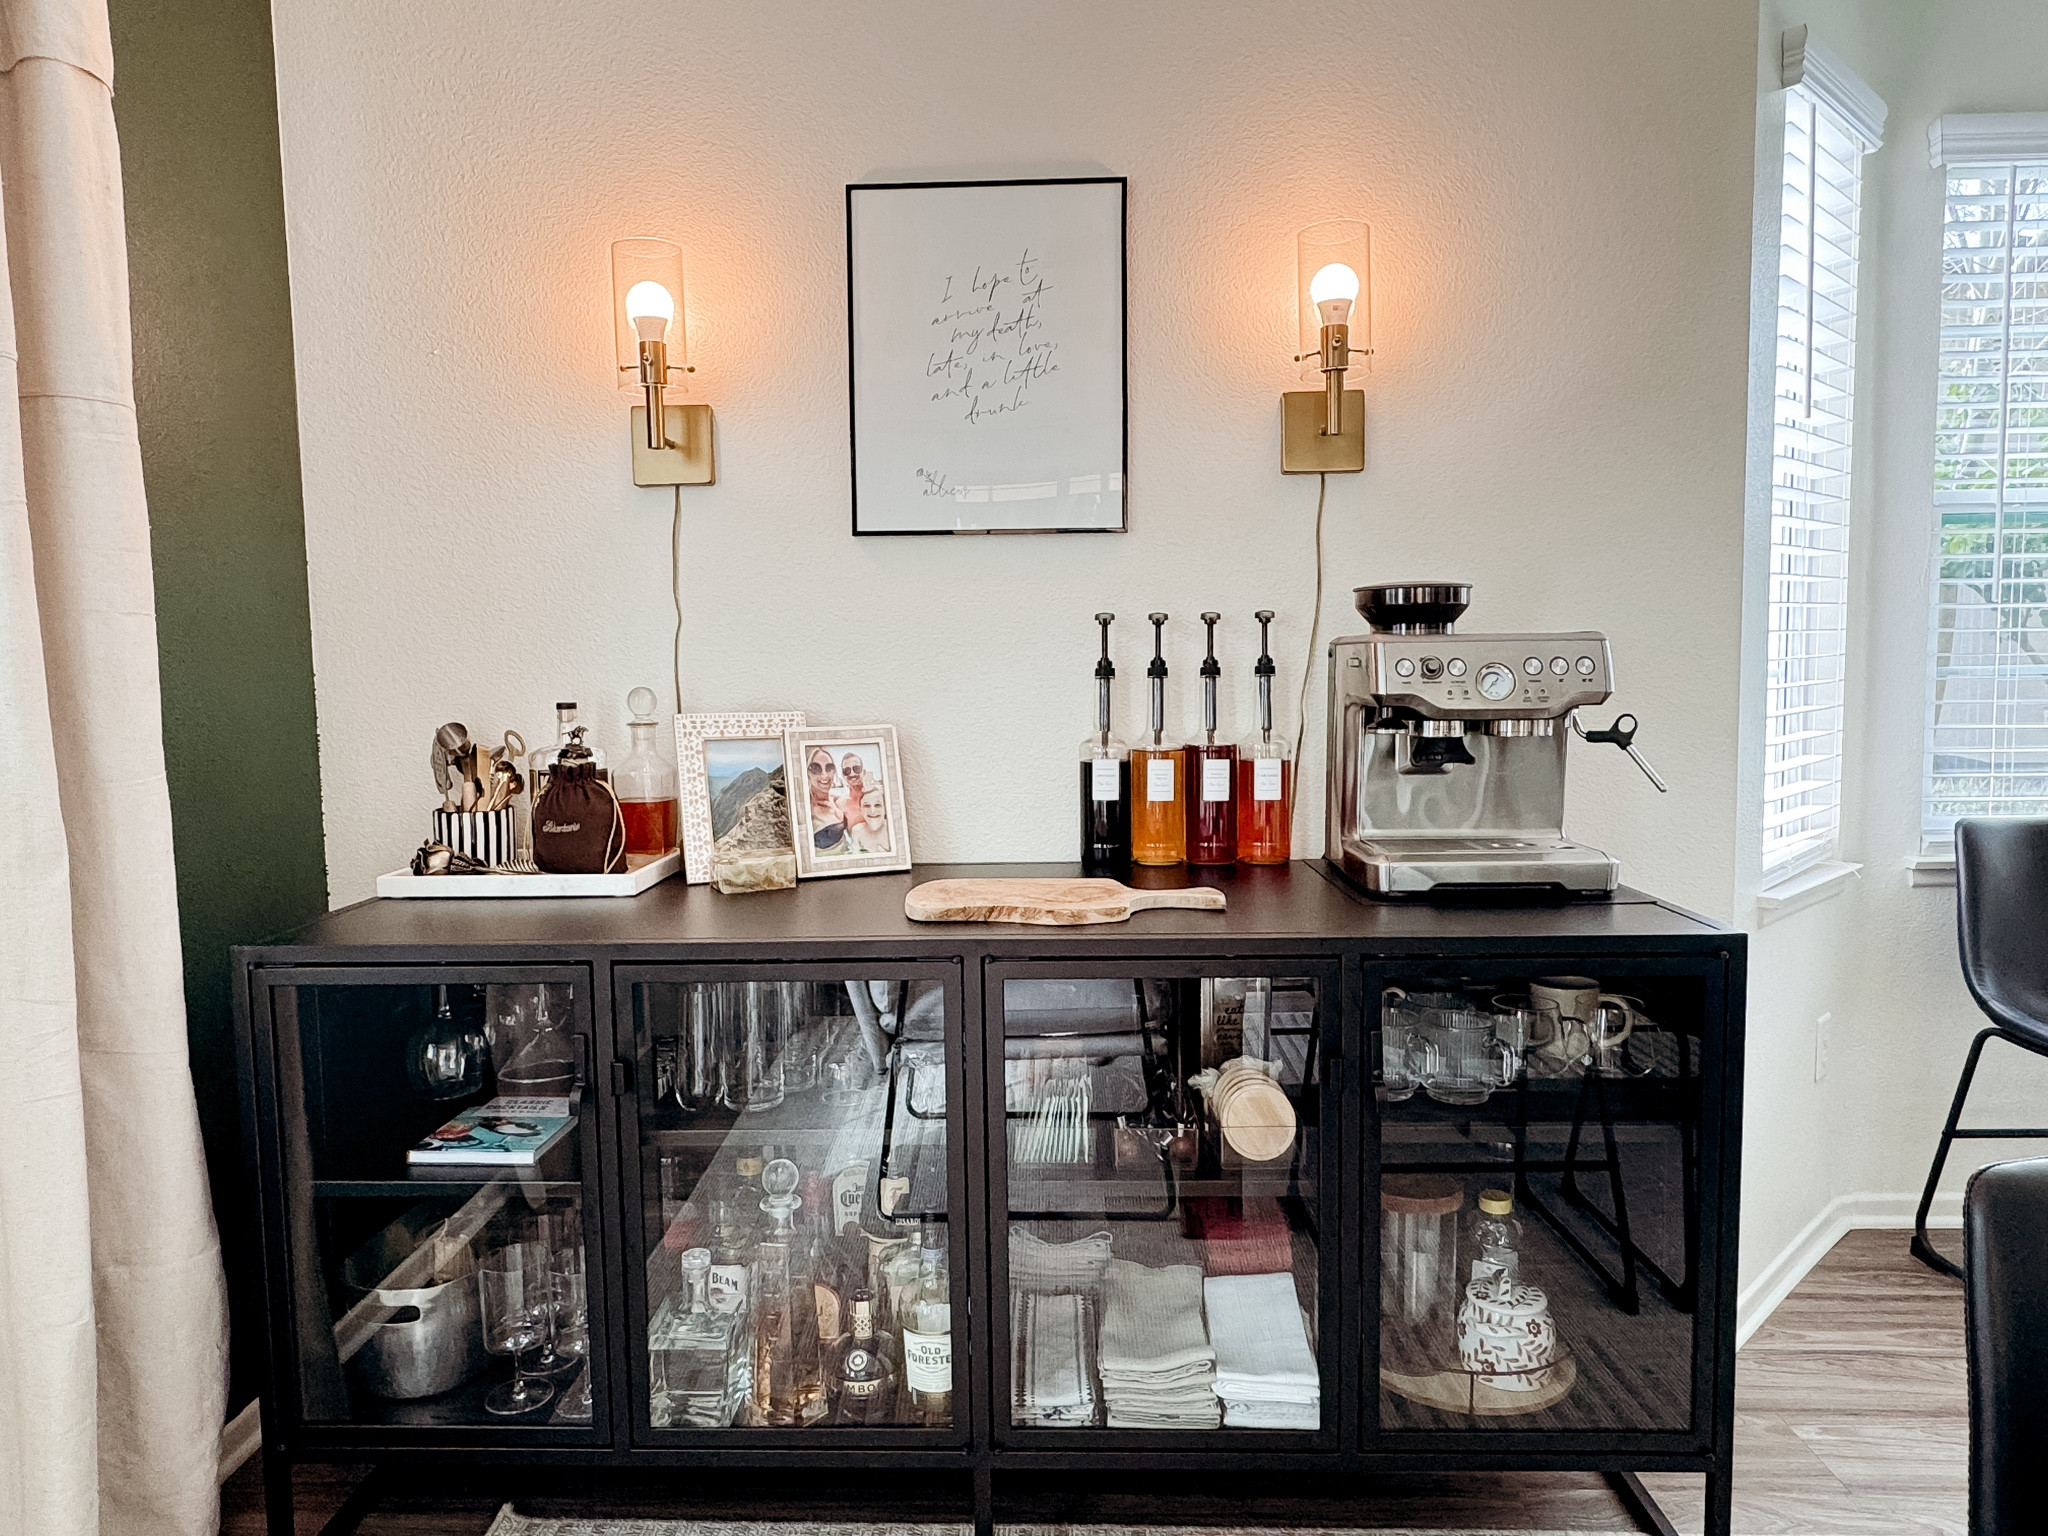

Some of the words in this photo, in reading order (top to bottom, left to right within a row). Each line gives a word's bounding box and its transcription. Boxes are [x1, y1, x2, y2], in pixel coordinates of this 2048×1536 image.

[941, 275, 953, 304] I
[972, 265, 1013, 303] hope
[1016, 248, 1039, 286] to
[931, 304, 995, 326] arrive
[1022, 278, 1054, 309] at
[951, 327, 985, 355] my
[982, 351, 1007, 363] in
[931, 367, 973, 402] and
[981, 379, 997, 390] a
[1003, 350, 1061, 390] little
[840, 1189, 861, 1207] Cue
[712, 1272, 739, 1291] BEAM
[907, 1348, 951, 1366] FORESTE
[920, 1345, 941, 1355] OLD
[846, 1383, 876, 1394] MBO
